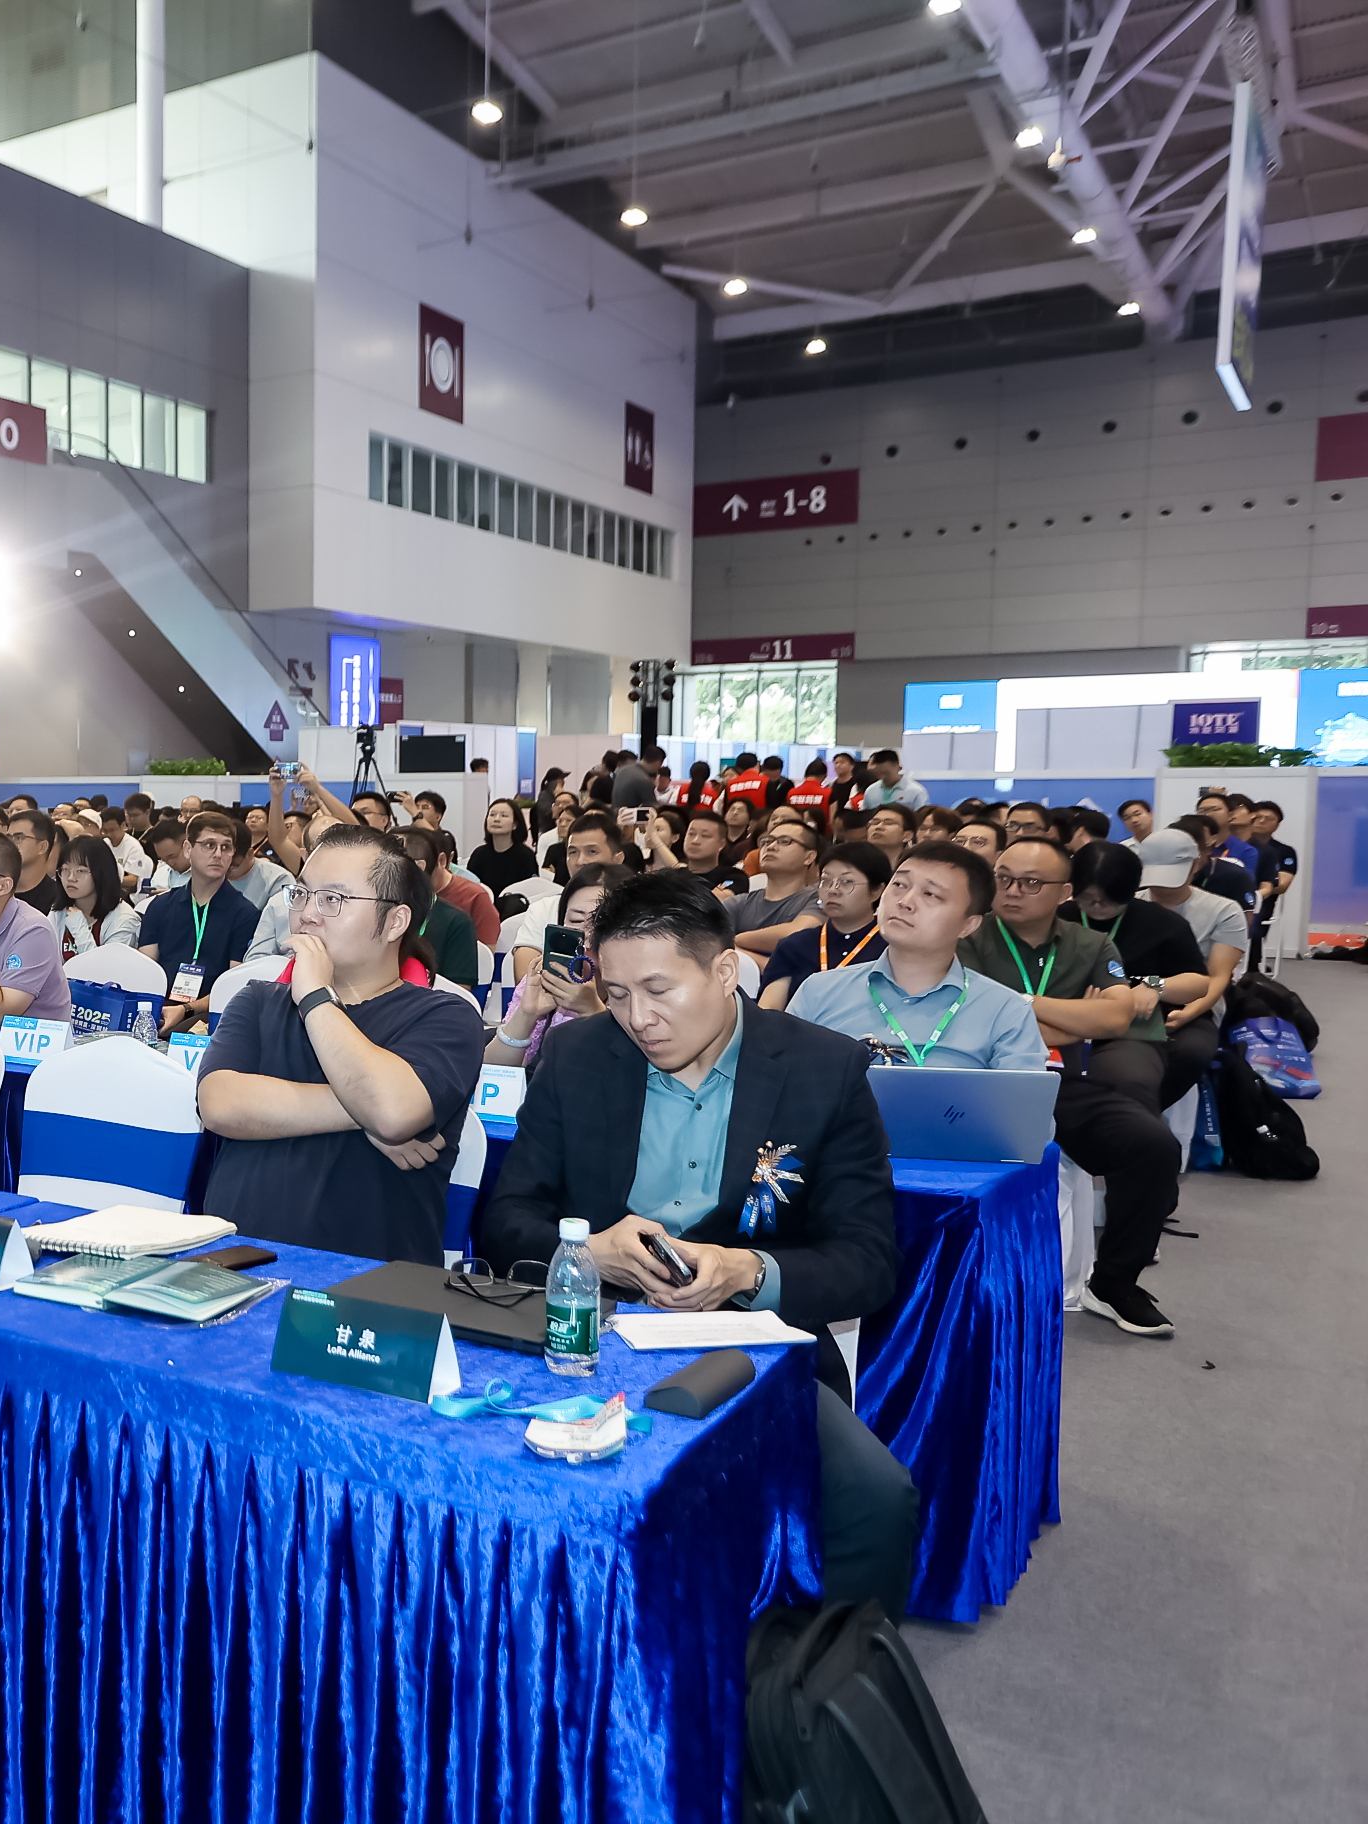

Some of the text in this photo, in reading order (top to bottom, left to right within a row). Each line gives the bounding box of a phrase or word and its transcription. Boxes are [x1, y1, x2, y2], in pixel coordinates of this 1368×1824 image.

[783, 485, 827, 517] 1-8
[772, 639, 793, 660] 11
[77, 1006, 111, 1024] 2025
[14, 1031, 51, 1053] VIP
[335, 1323, 376, 1351] 甘 泉
[326, 1343, 381, 1365] LoRa Alliance
